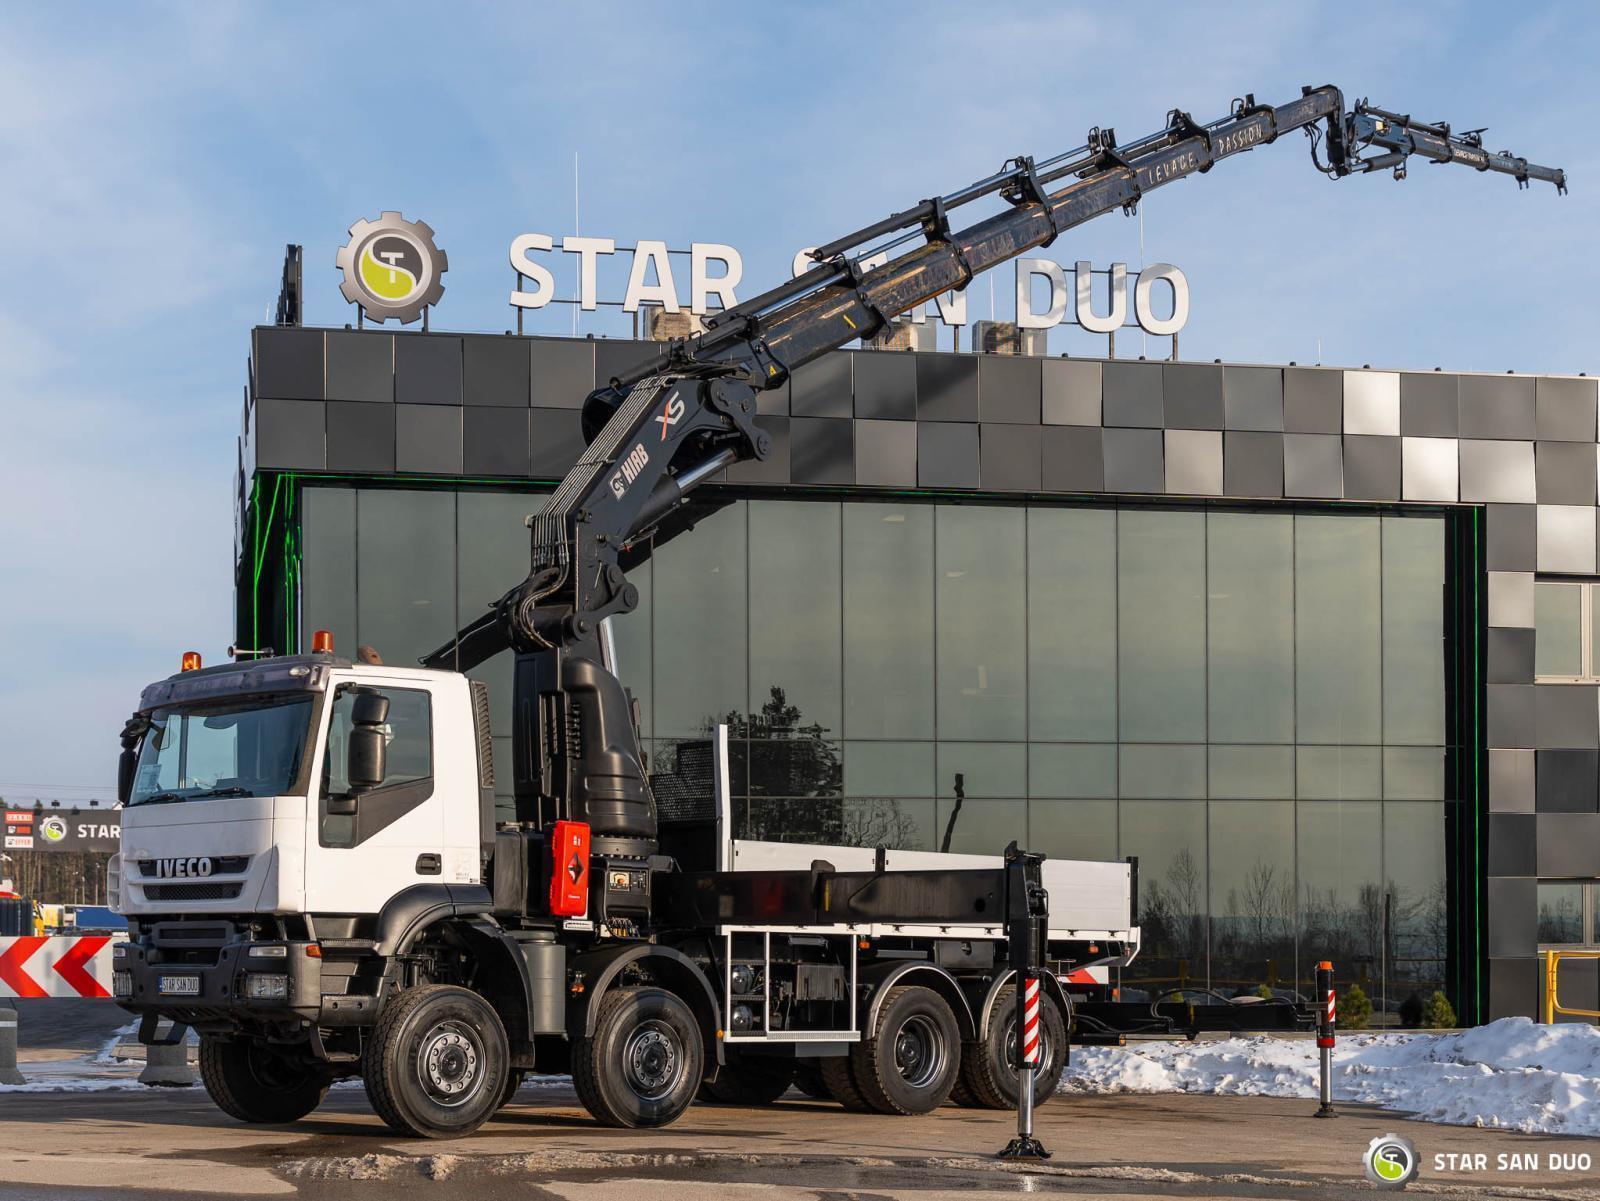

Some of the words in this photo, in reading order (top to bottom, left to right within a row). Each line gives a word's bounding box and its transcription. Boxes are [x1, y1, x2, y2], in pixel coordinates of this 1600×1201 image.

[1218, 123, 1263, 155] PASSION
[509, 233, 743, 315] STAR
[1015, 258, 1191, 336] DUO
[620, 443, 649, 485] HIAB
[77, 824, 120, 839] STAR
[156, 857, 212, 878] IVECO
